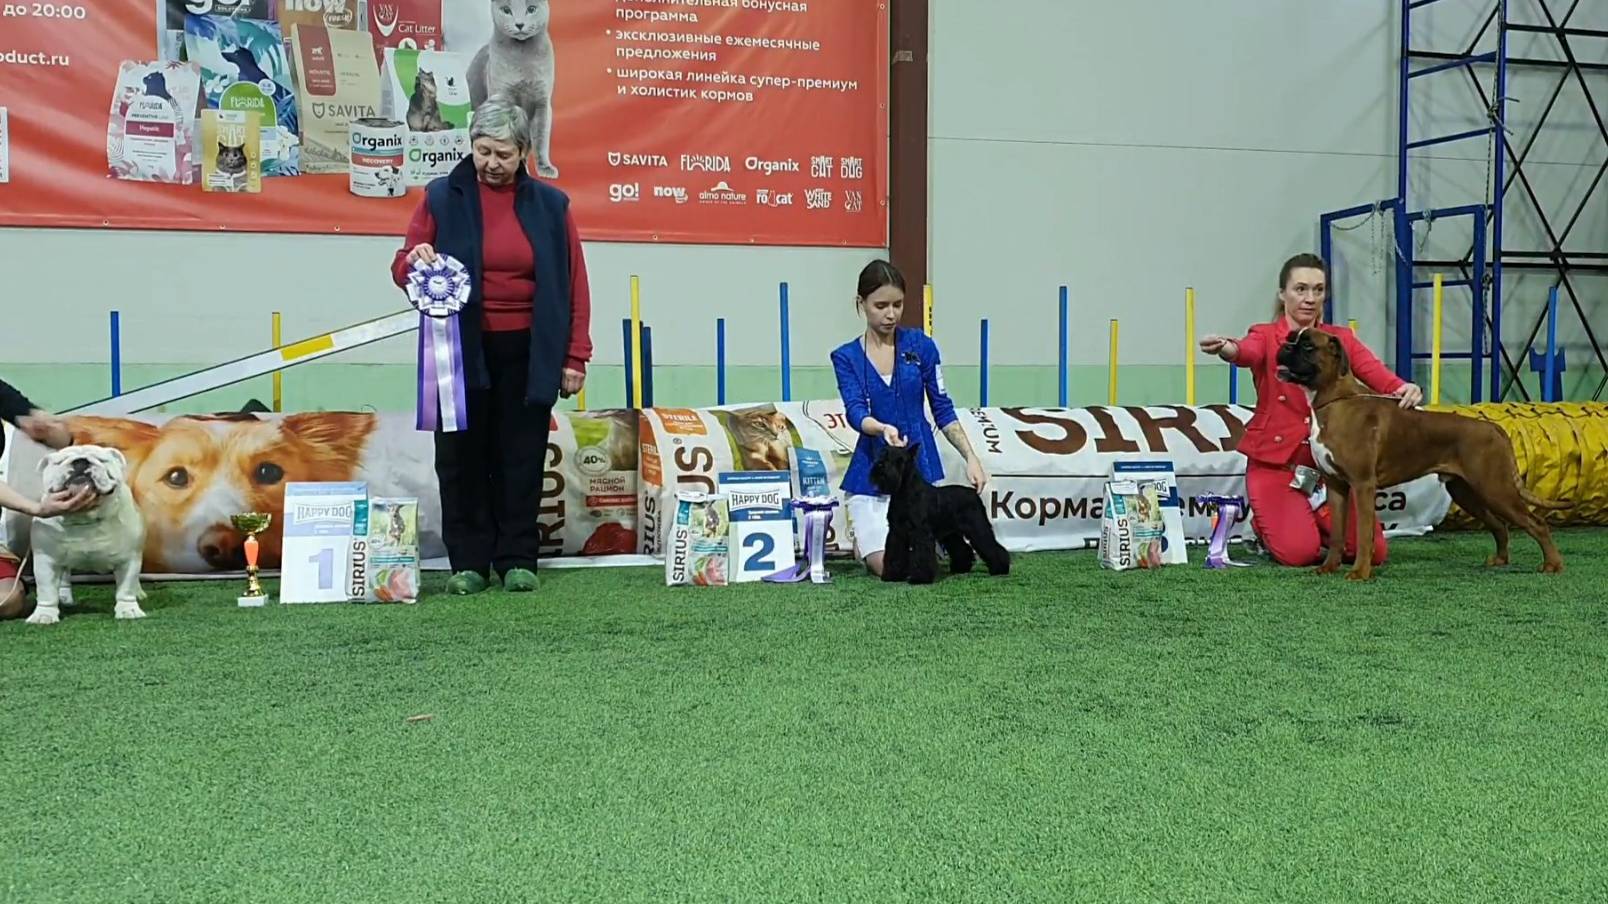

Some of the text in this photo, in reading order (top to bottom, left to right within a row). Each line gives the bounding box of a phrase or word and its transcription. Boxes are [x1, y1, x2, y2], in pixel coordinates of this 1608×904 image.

[3, 3, 86, 20] до 20:00
[616, 0, 807, 12] нительная бонусная
[616, 8, 698, 22] программа
[398, 23, 437, 34] Cat Litter
[616, 30, 820, 50] эксклюзивные ежемесячные
[616, 46, 717, 61] предложения
[616, 68, 858, 92] широкая линейка супер-премиум
[617, 85, 754, 102] и холистик кормов
[328, 104, 376, 117] SAVITA
[352, 132, 403, 151] Organix
[409, 148, 464, 167] Organix
[622, 153, 668, 167] SAVITA
[745, 157, 800, 175] Organix
[609, 182, 640, 202] go!
[653, 186, 686, 197] now
[699, 191, 747, 201] almo nature
[804, 189, 832, 201] WHITE
[806, 199, 830, 209] SAND
[583, 455, 606, 465] 40%
[731, 493, 780, 506] HAPPY DOG
[297, 506, 330, 520] HAPPY
[991, 491, 1103, 526] Корма
[1117, 518, 1131, 566] SIRIUS
[672, 529, 688, 582] SIRIUS
[743, 532, 776, 572] 2
[308, 548, 334, 590] 1
[352, 541, 367, 597] SIRIUS
